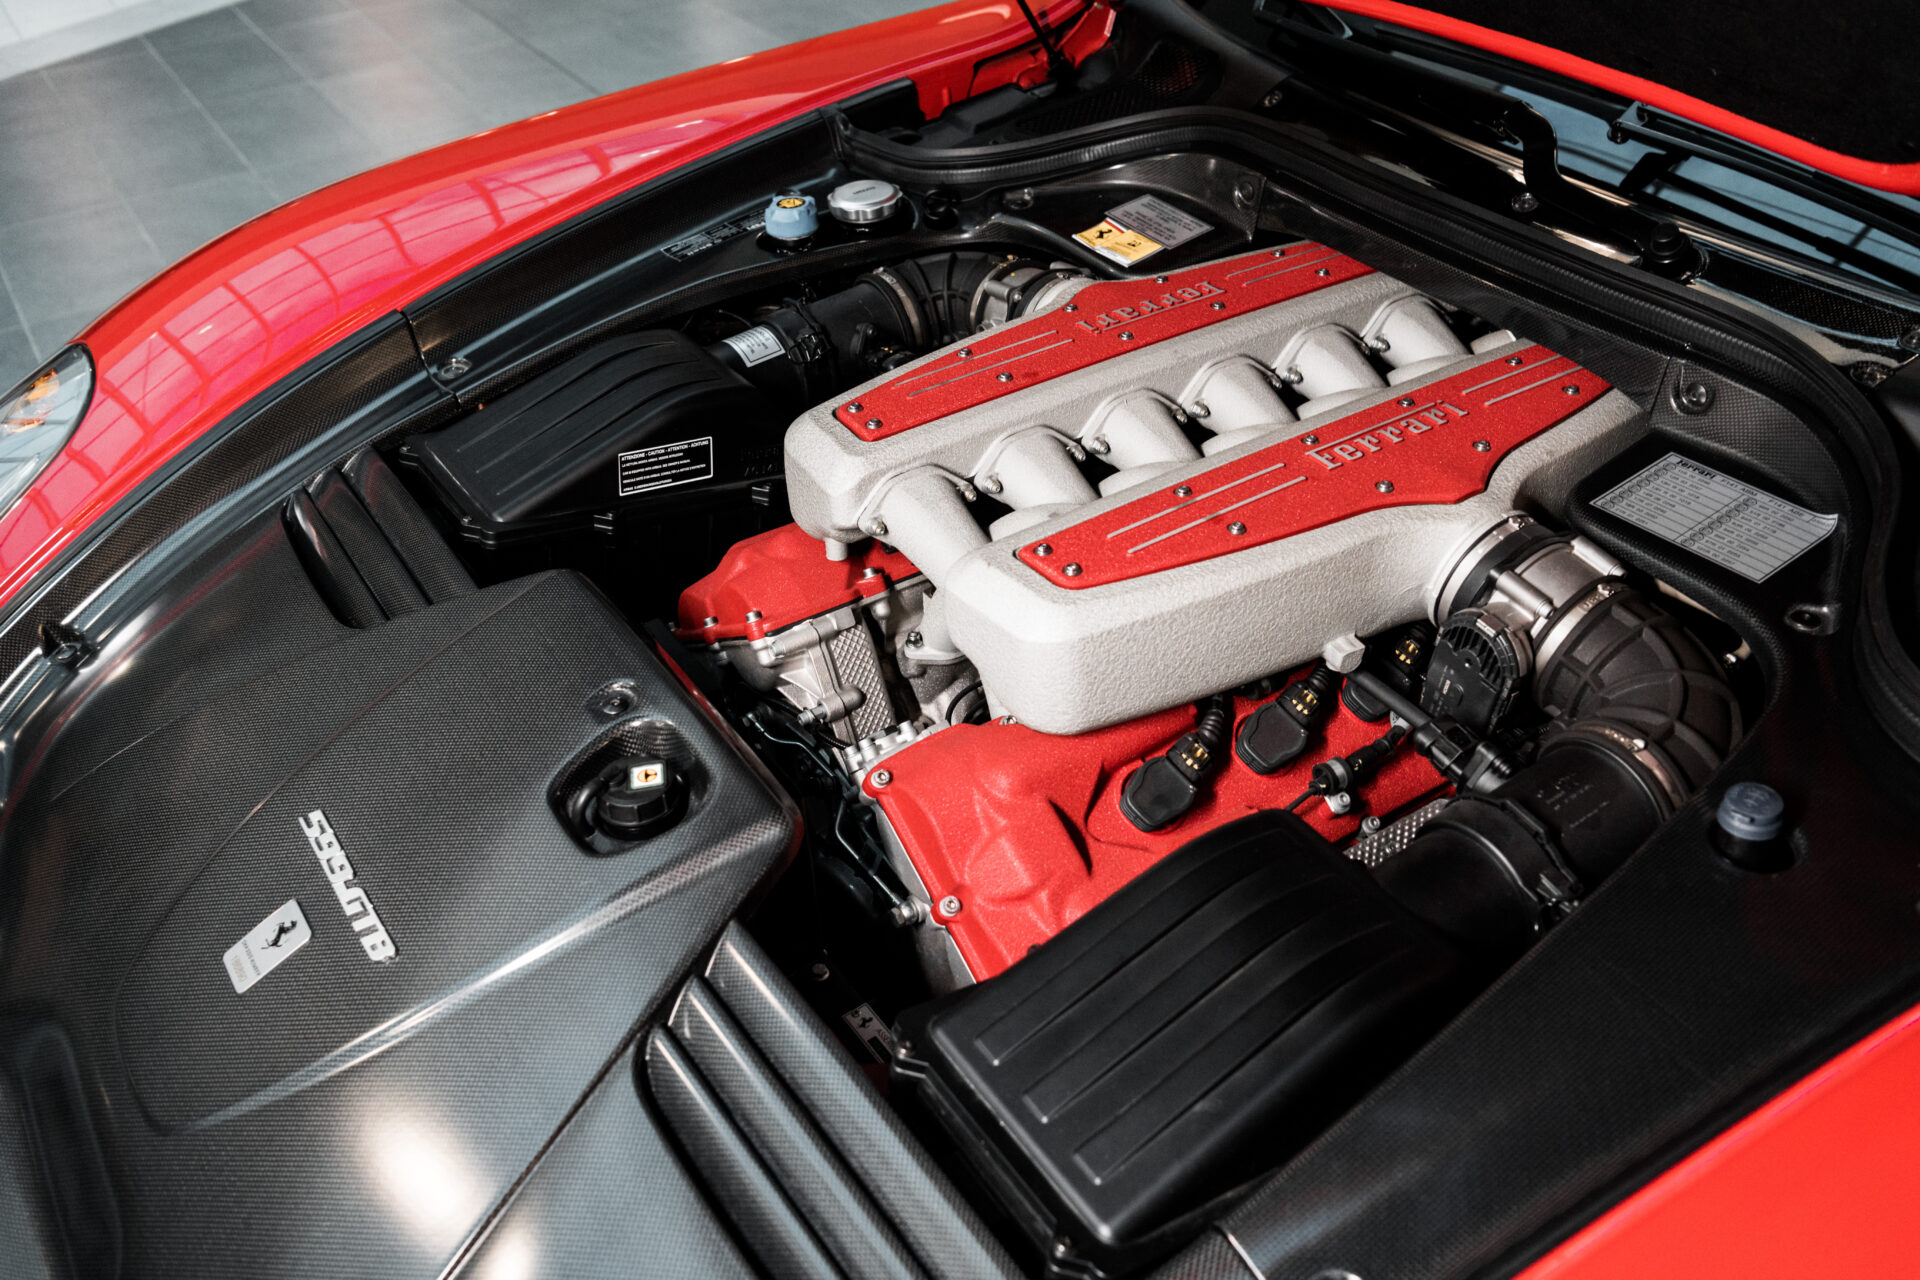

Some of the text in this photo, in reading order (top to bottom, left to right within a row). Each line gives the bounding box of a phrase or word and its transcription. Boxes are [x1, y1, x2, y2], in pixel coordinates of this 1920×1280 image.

[1076, 281, 1227, 334] Ferrari
[621, 452, 646, 462] ATTENZIONE
[647, 448, 665, 457] CAUTION
[667, 443, 689, 453] ATTENTION
[690, 440, 709, 448] ACHTUNG
[1305, 400, 1470, 470] Ferrari
[1676, 459, 1718, 480] Ferrari
